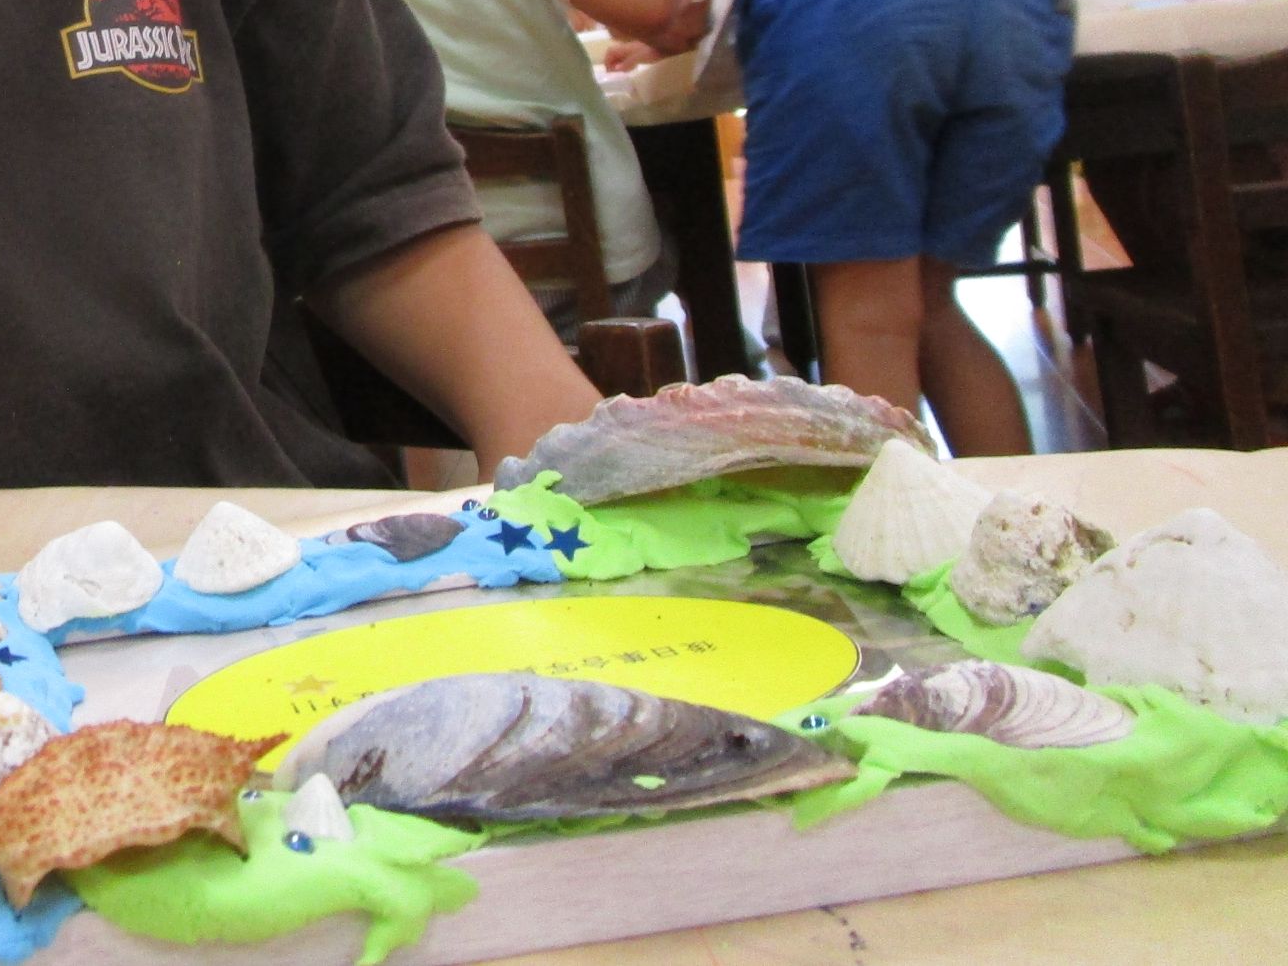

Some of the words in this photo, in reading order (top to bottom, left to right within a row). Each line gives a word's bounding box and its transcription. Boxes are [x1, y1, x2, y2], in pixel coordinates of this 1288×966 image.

[512, 639, 718, 676] 後日集合写
